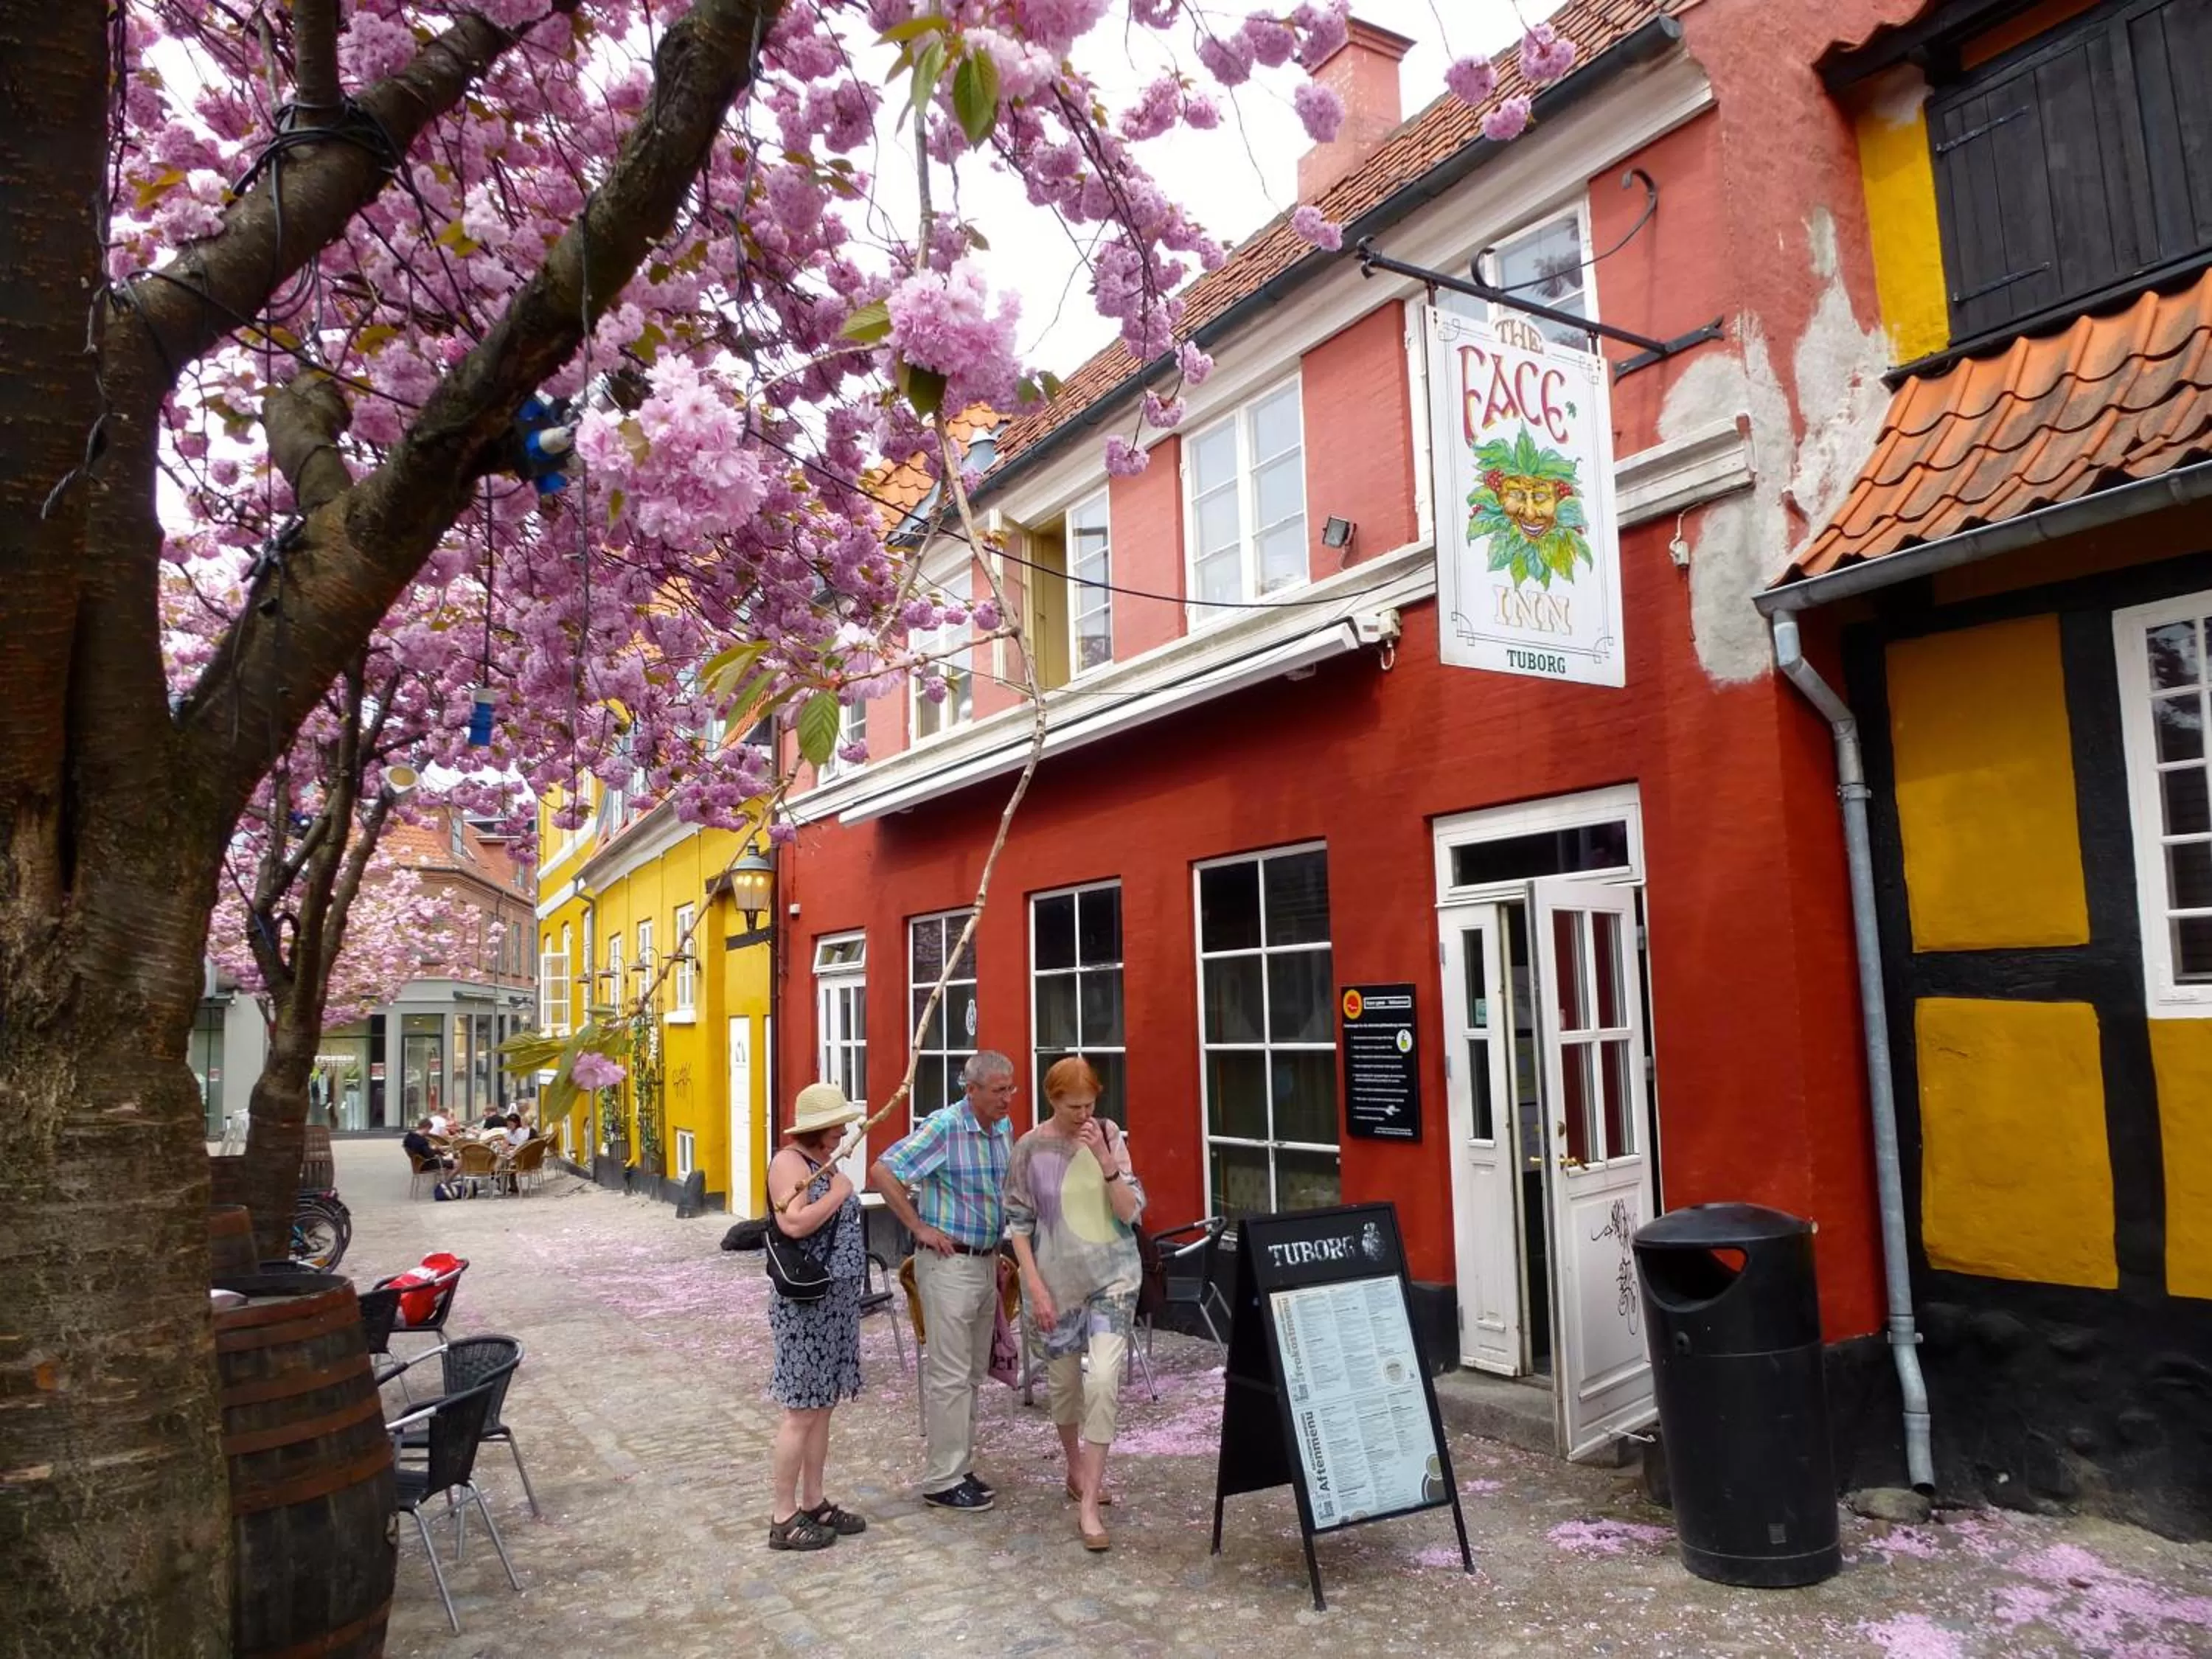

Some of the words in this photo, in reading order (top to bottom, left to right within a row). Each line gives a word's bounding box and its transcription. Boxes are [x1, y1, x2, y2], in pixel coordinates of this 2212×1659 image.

[1495, 318, 1545, 355] THE
[1457, 344, 1569, 448] FACE
[1492, 584, 1573, 636] INN
[1506, 649, 1567, 674] TUBORG
[1267, 1235, 1355, 1267] TUBORG
[1305, 1411, 1330, 1491] Aftenmenu
